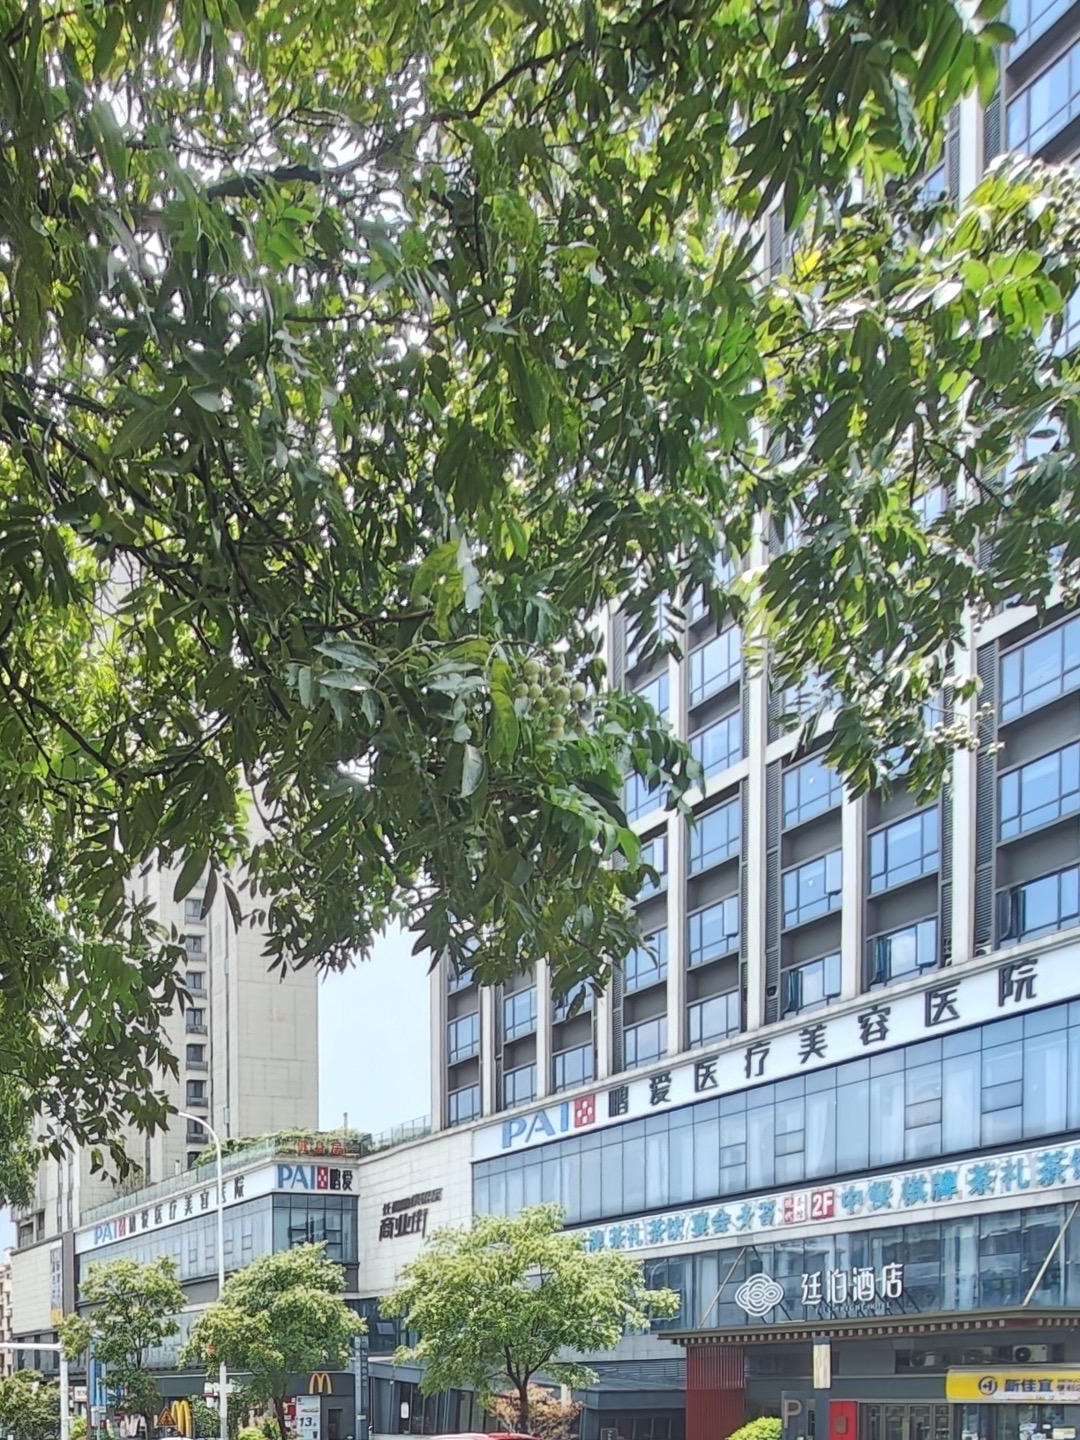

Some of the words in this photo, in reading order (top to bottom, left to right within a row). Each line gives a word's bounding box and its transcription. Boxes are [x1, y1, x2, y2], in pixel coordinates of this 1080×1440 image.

[608, 957, 1039, 1118] 鹏爱医疗美容医院
